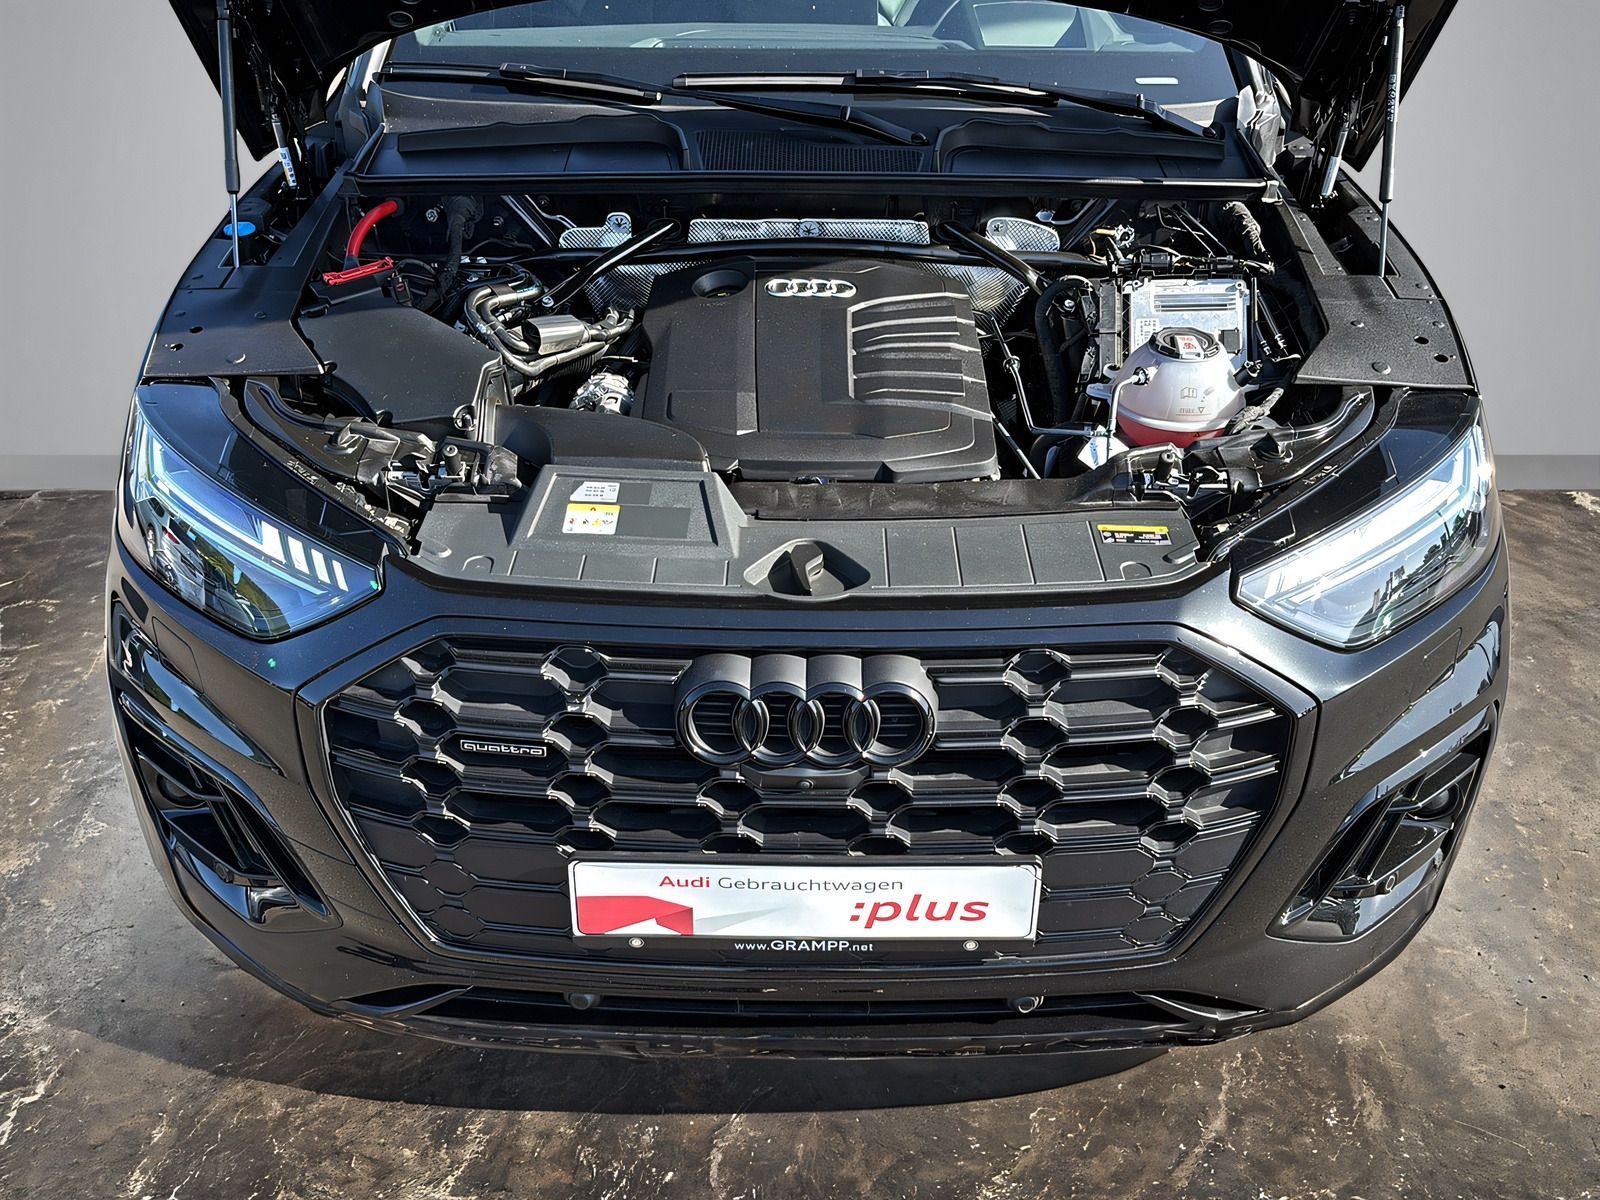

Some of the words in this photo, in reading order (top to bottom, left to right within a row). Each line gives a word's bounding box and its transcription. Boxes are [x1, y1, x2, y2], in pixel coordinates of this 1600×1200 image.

[463, 743, 543, 755] quattro
[658, 875, 711, 888] Audi
[717, 876, 904, 894] Gebrauchtwagen
[849, 893, 990, 929] :plus
[734, 939, 874, 953] www.GRAMPP.net
